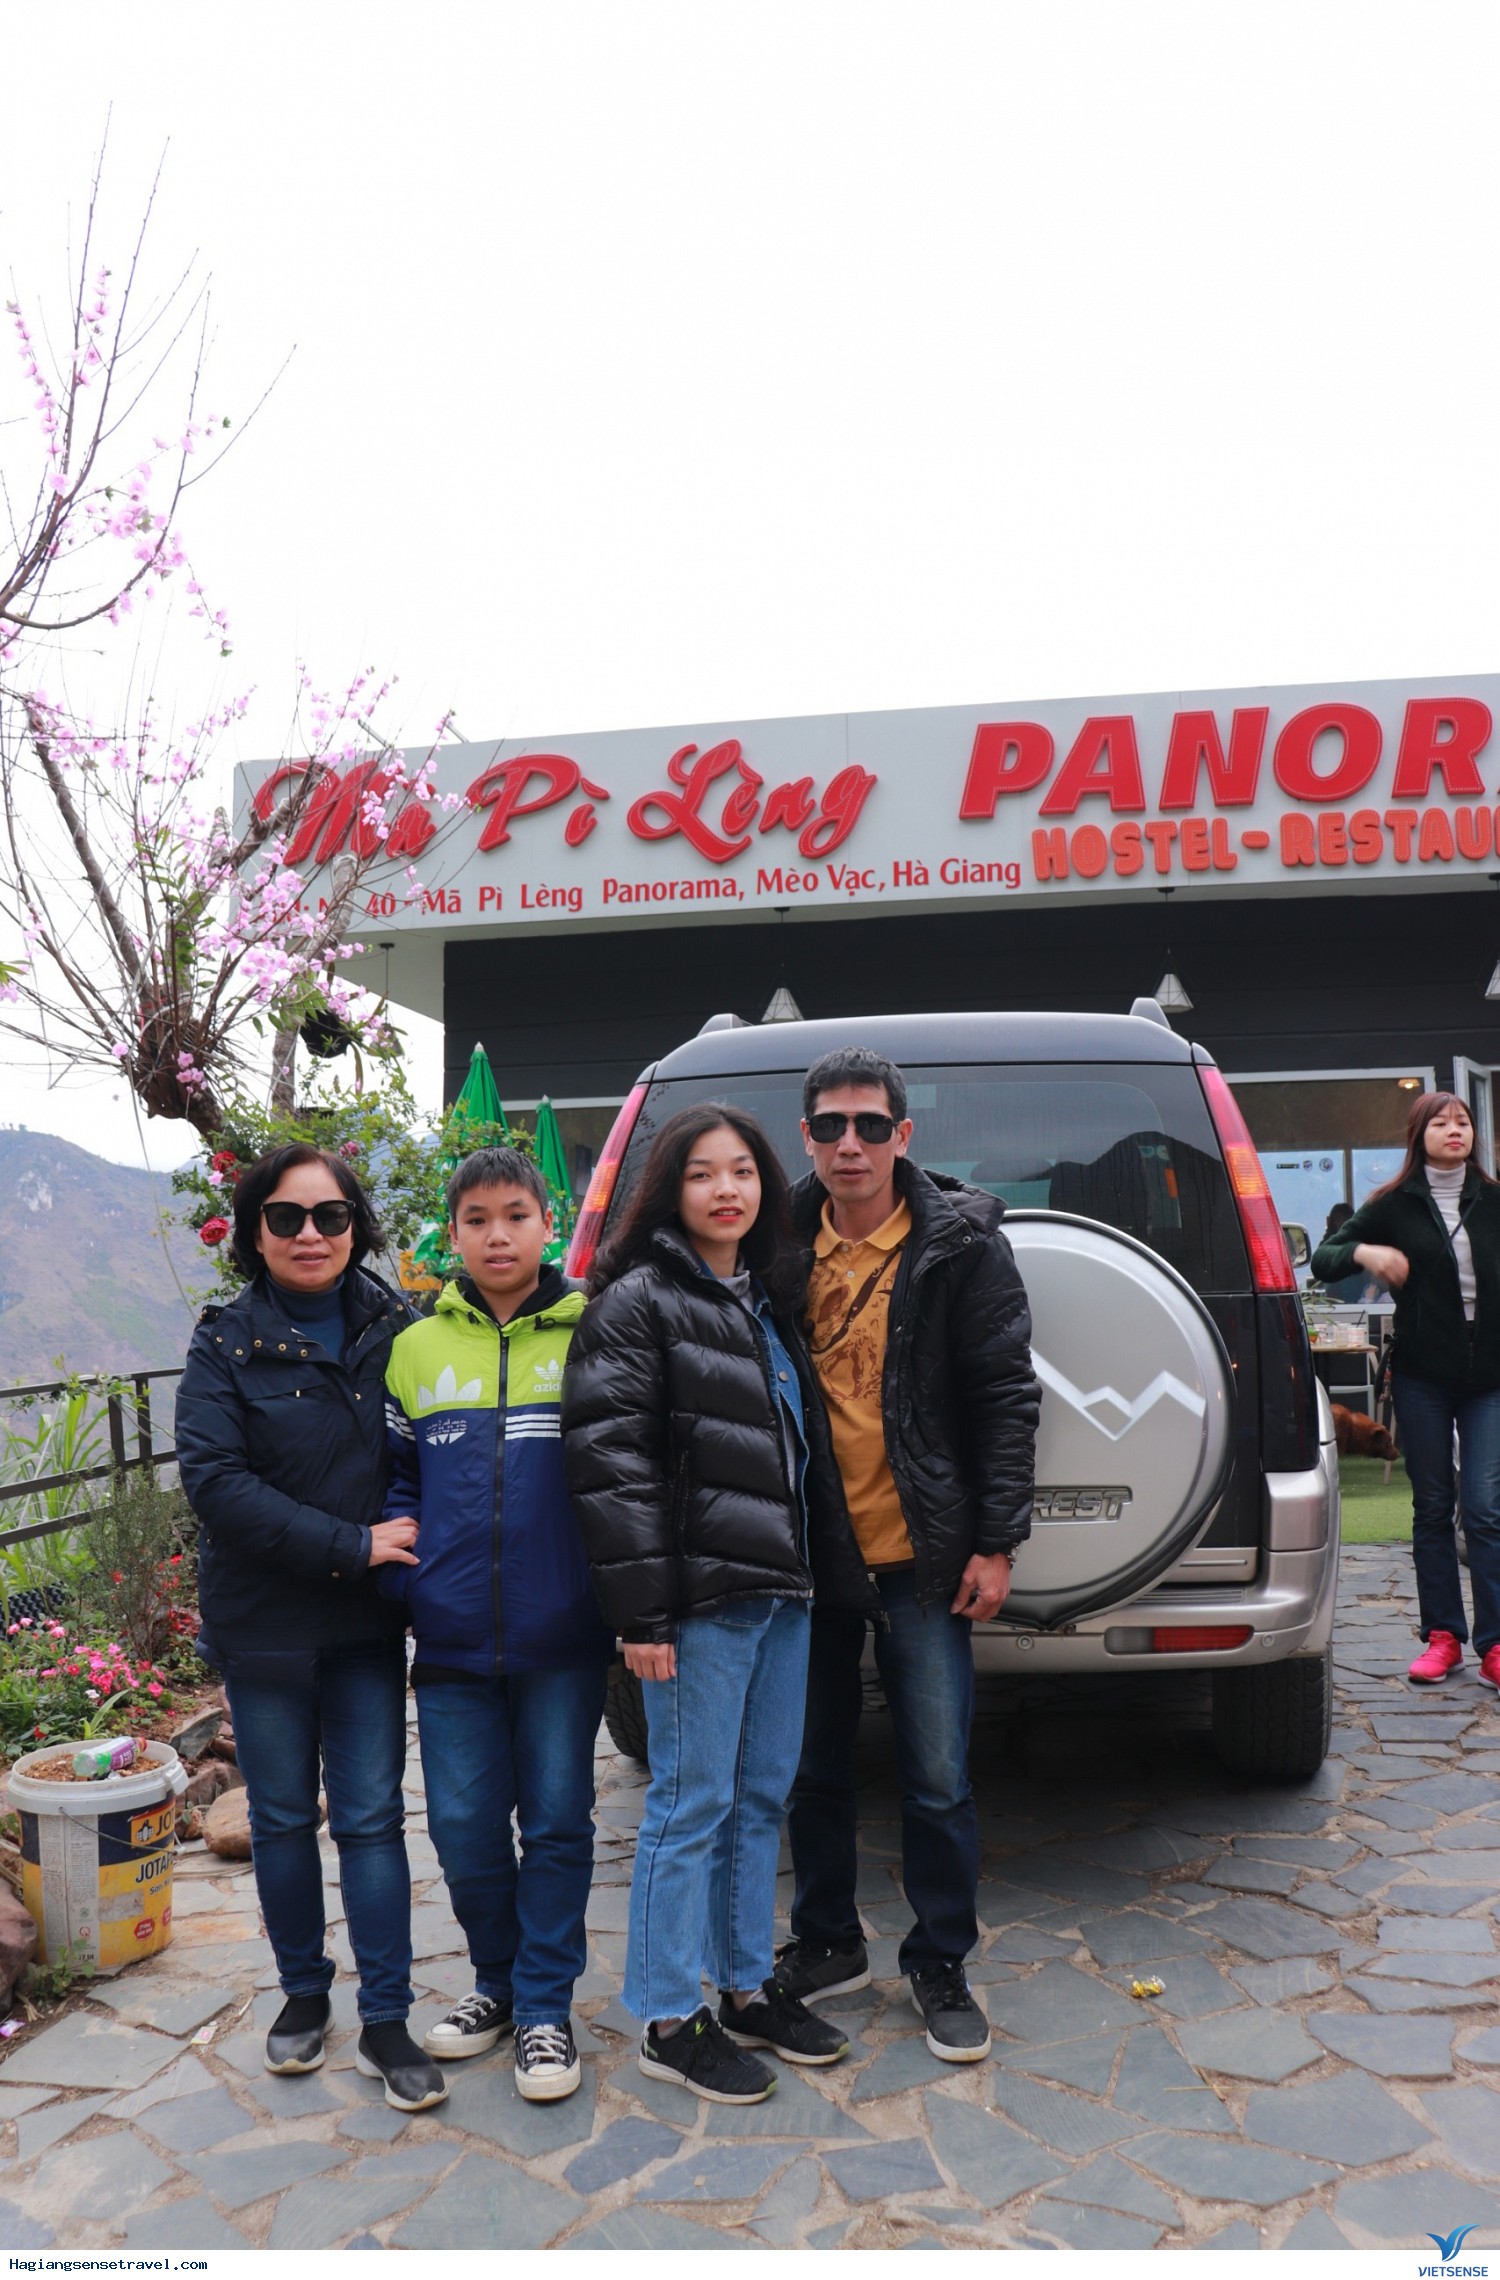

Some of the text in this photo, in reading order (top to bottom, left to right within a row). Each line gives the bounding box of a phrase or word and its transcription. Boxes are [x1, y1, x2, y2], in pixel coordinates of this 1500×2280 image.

[465, 753, 610, 852] Pì
[626, 738, 878, 863] Lèng
[958, 696, 1500, 820] PANOR
[365, 892, 397, 918] 40
[478, 885, 503, 912] Pì
[520, 882, 583, 913] Lèng
[602, 877, 745, 904] Panorama,
[756, 867, 820, 895] Mèo
[826, 863, 886, 897] Vạc,
[892, 860, 930, 888] Hà
[939, 857, 1021, 889] Giang
